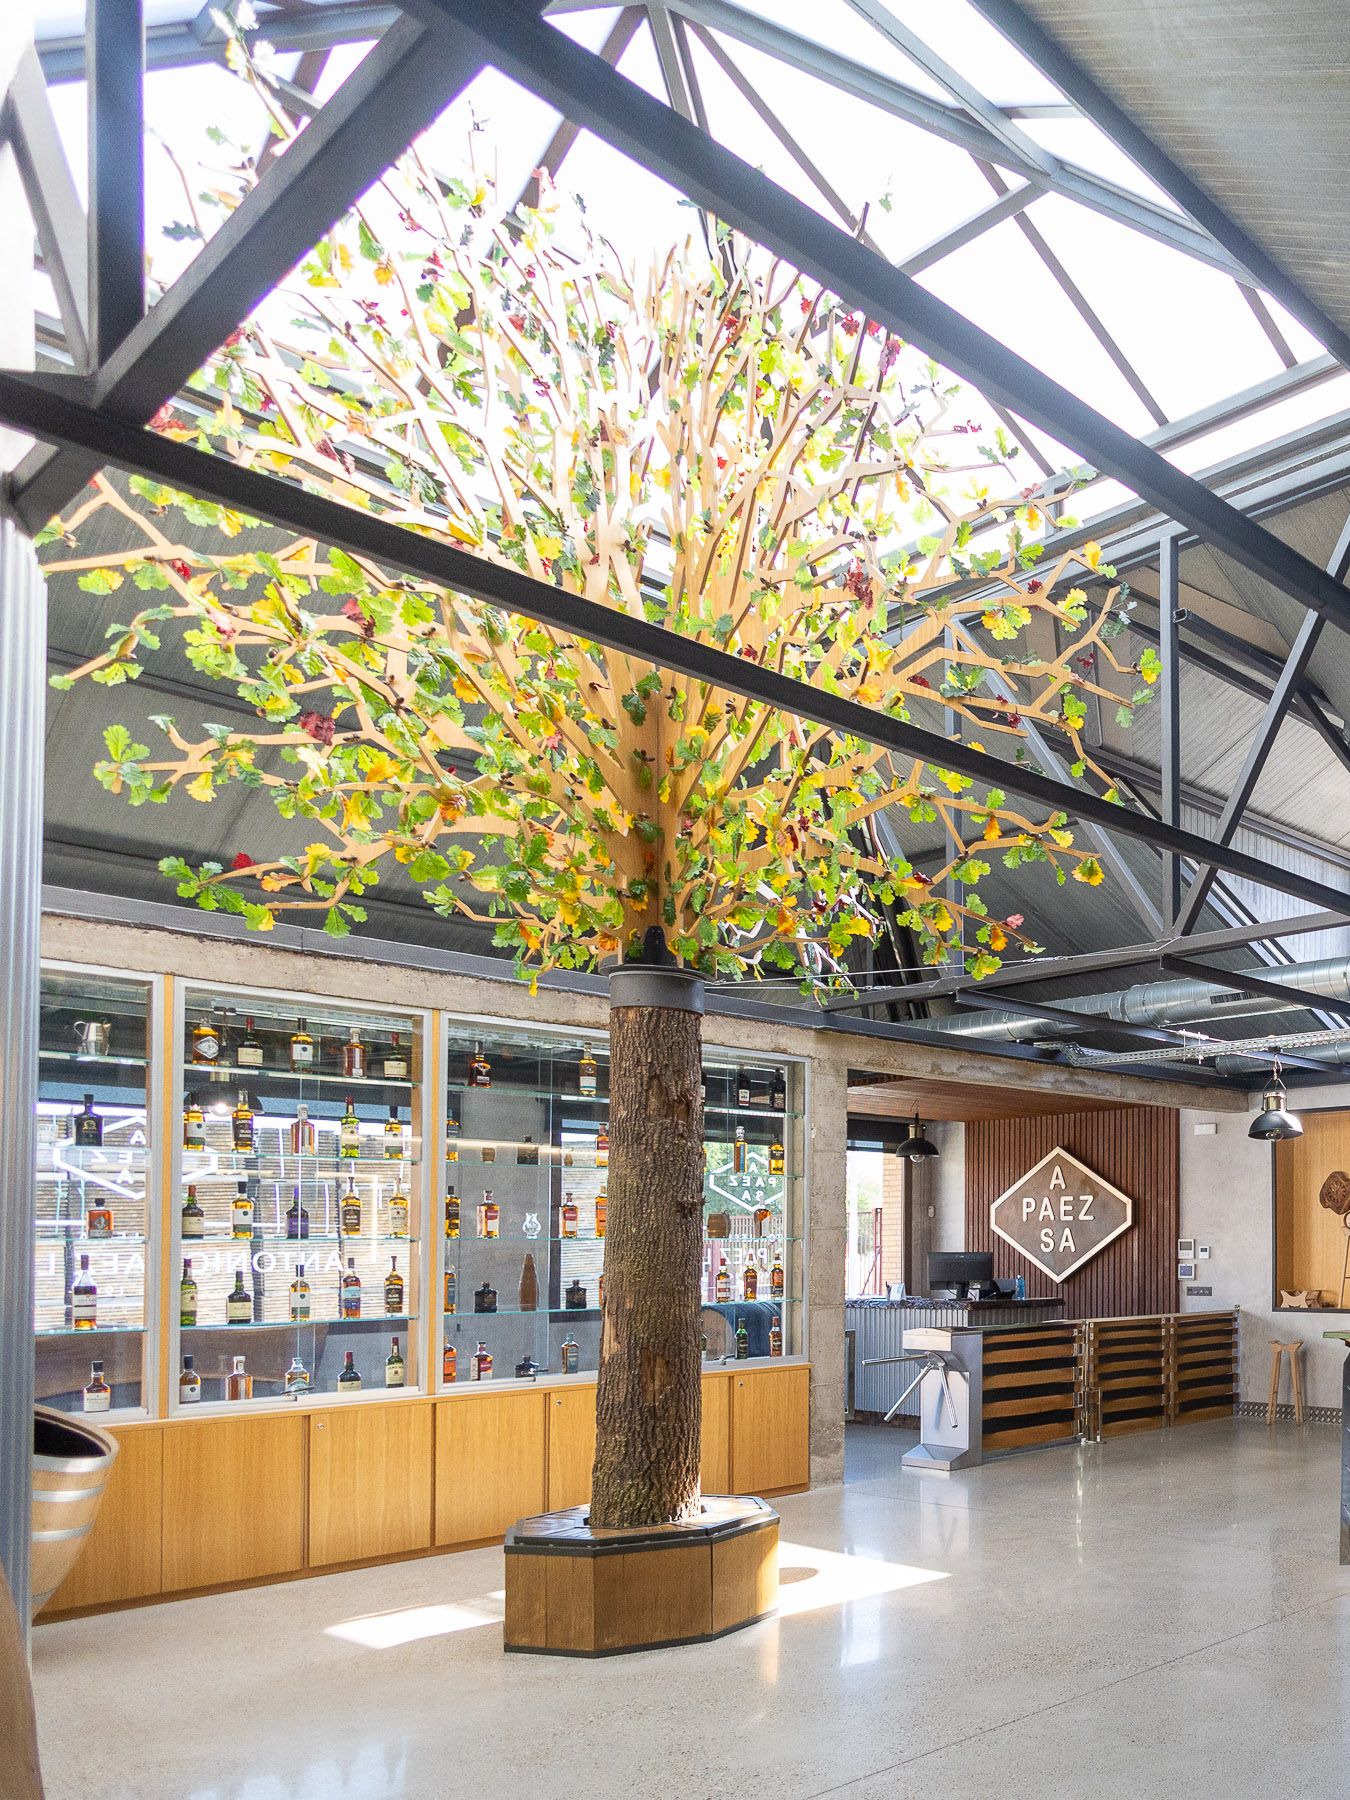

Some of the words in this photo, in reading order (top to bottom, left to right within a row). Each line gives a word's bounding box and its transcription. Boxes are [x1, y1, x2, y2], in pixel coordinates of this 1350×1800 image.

[1050, 1165, 1066, 1190] A
[1022, 1195, 1095, 1222] PAEZ
[1040, 1227, 1076, 1252] SA
